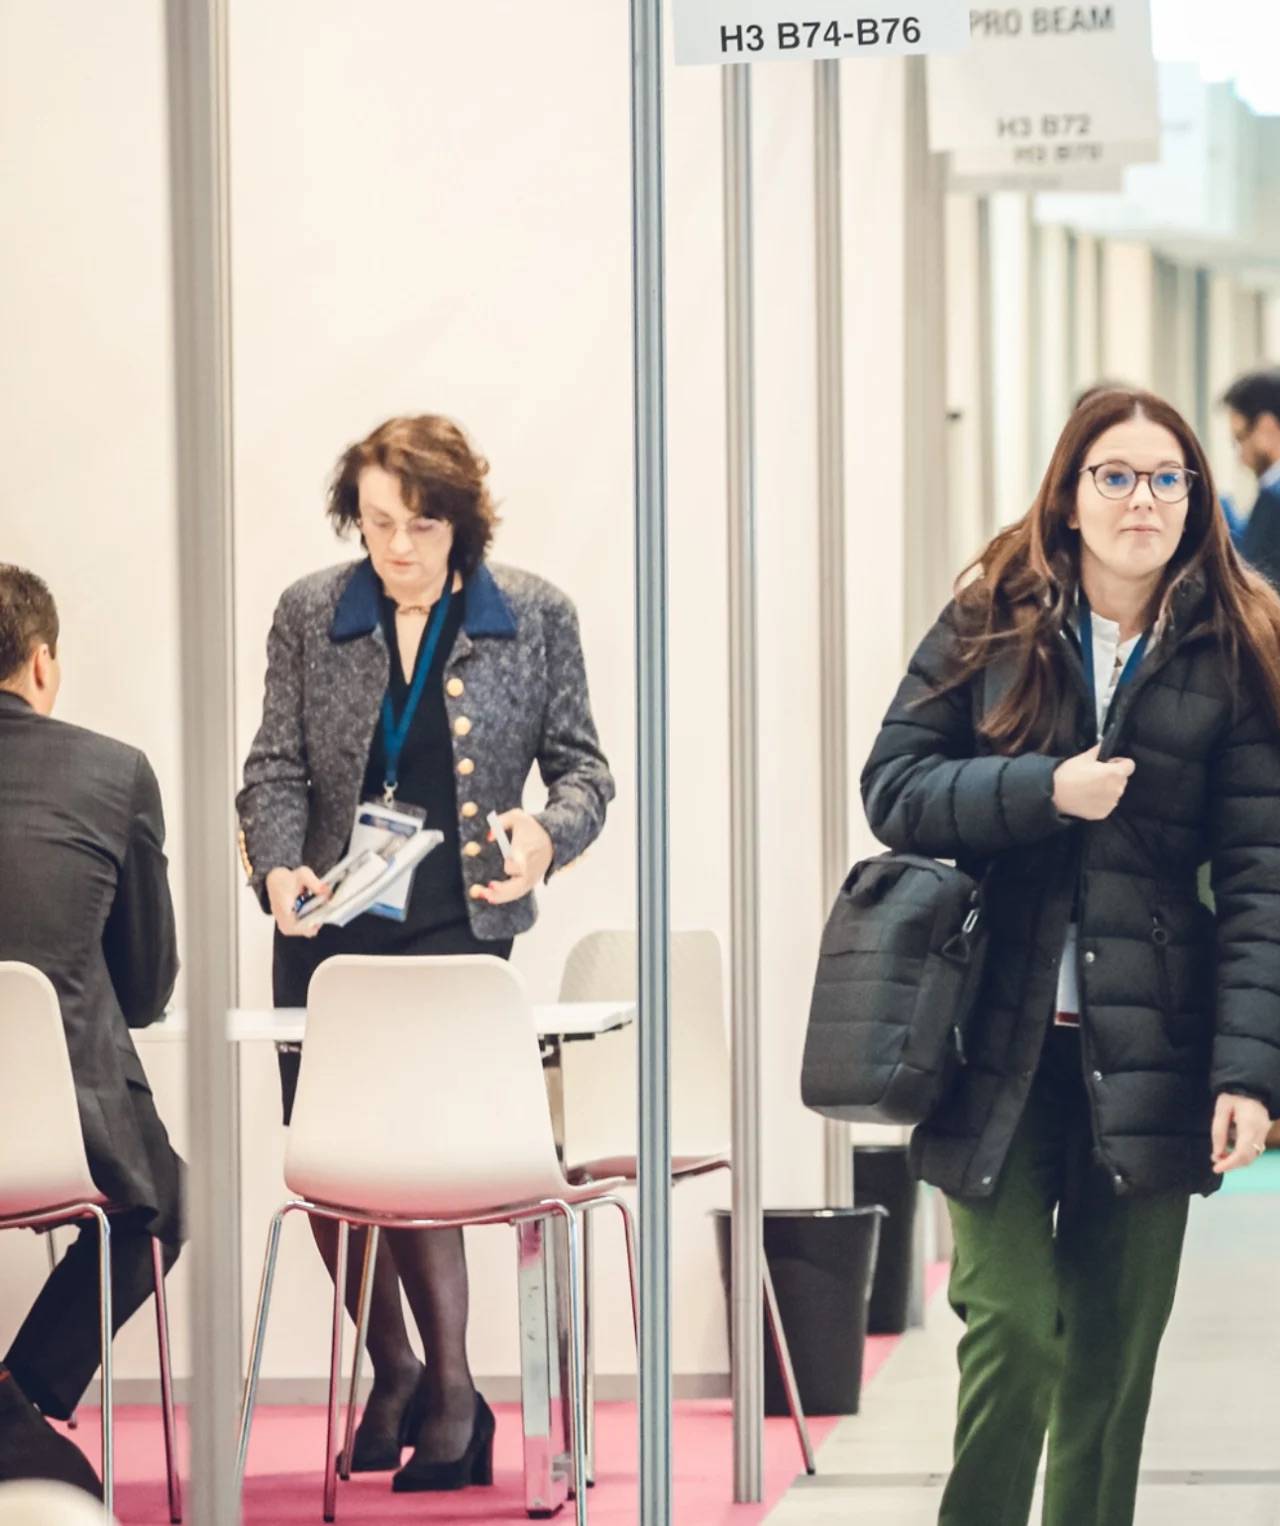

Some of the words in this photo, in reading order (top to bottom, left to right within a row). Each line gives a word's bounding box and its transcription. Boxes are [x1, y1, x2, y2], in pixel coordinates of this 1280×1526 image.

[720, 25, 764, 52] H3
[778, 16, 921, 50] B74-B76
[969, 8, 1022, 37] PRO
[1032, 5, 1115, 34] BEAM
[998, 116, 1032, 137] H3
[1041, 113, 1091, 136] B72
